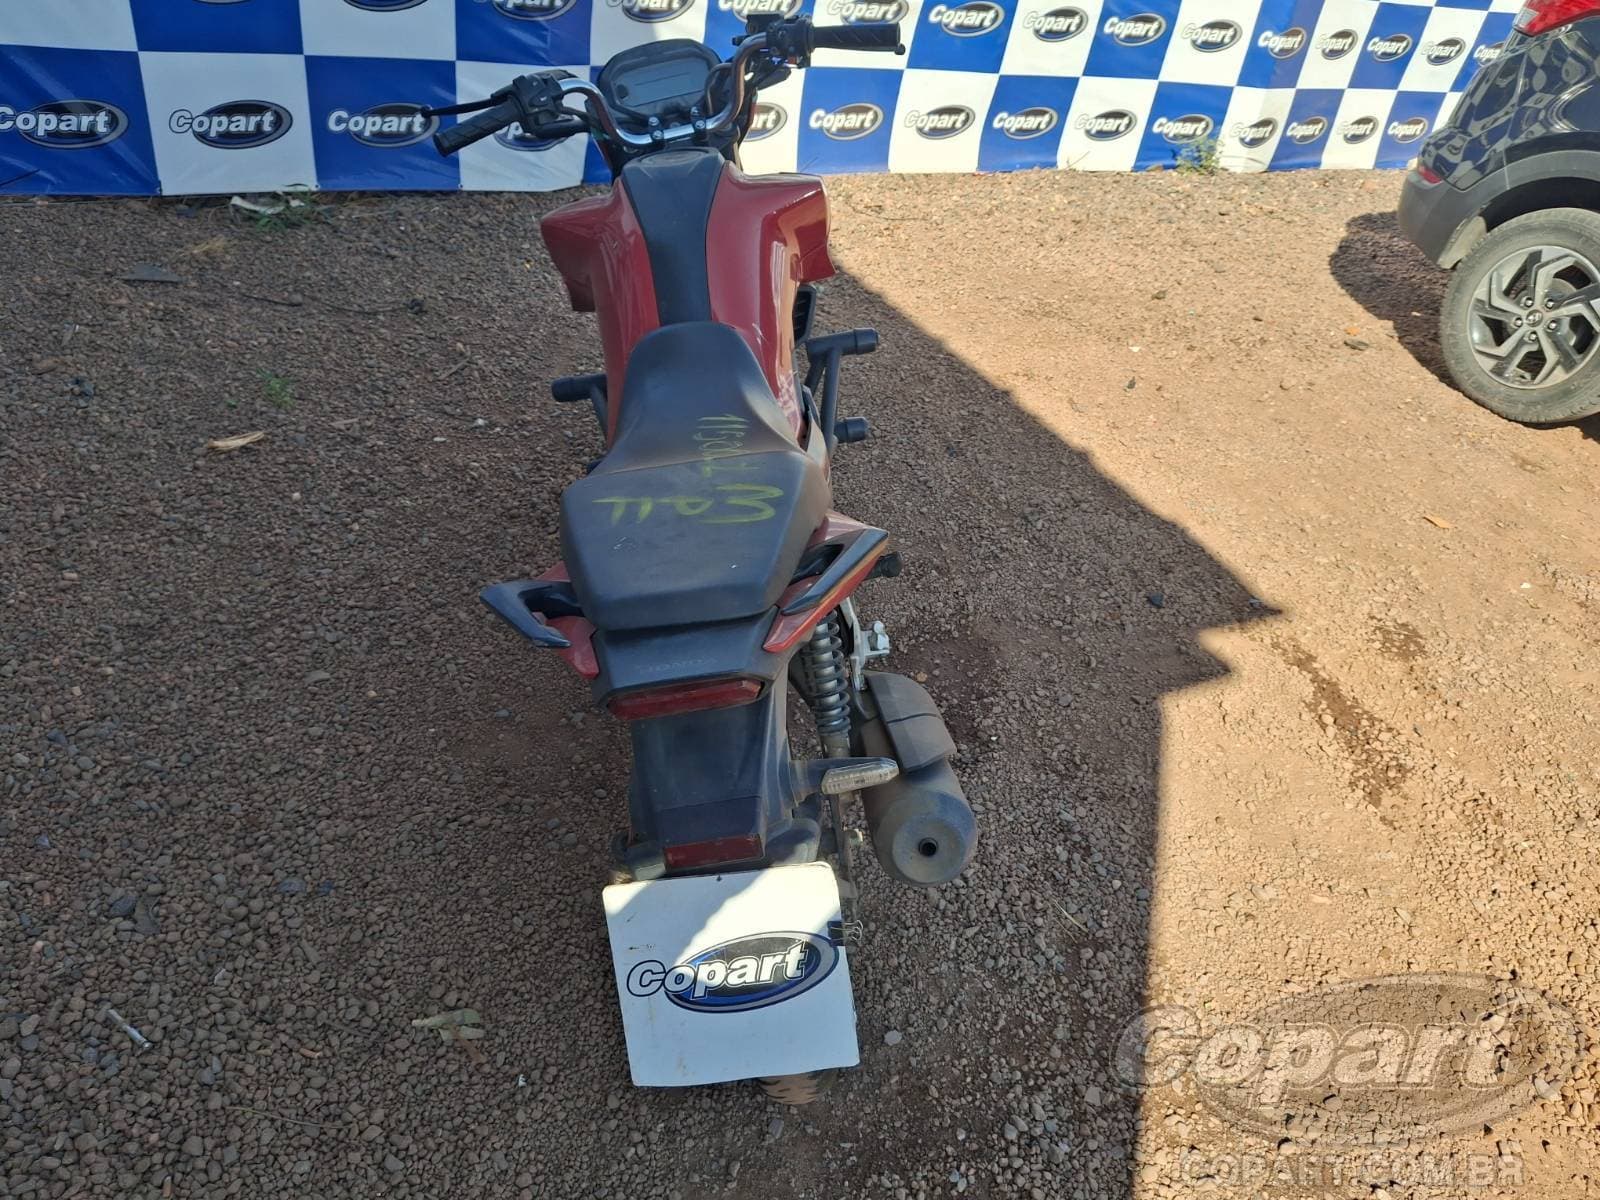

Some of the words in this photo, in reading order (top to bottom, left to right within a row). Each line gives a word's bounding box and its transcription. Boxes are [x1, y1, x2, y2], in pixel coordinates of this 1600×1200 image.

[828, 0, 898, 20] Copart
[929, 4, 994, 27] Copart
[1024, 11, 1084, 33] Copart
[1104, 17, 1160, 39] Copart
[1181, 22, 1237, 44] Copart
[1257, 30, 1303, 53] Copart
[1367, 36, 1408, 55] Copart
[1421, 40, 1461, 59] Copart
[1473, 44, 1502, 61] Copa
[169, 108, 277, 138] Copart
[327, 109, 426, 137] Copart
[808, 108, 875, 133] Copart
[904, 110, 967, 132] Copart
[992, 112, 1051, 132] Copart
[1075, 114, 1130, 134] Copart
[1152, 116, 1207, 137] Copart
[1285, 121, 1324, 139] Copart
[1387, 121, 1423, 138] Copart
[1230, 122, 1274, 142] Copart
[626, 938, 809, 1000] Copart
